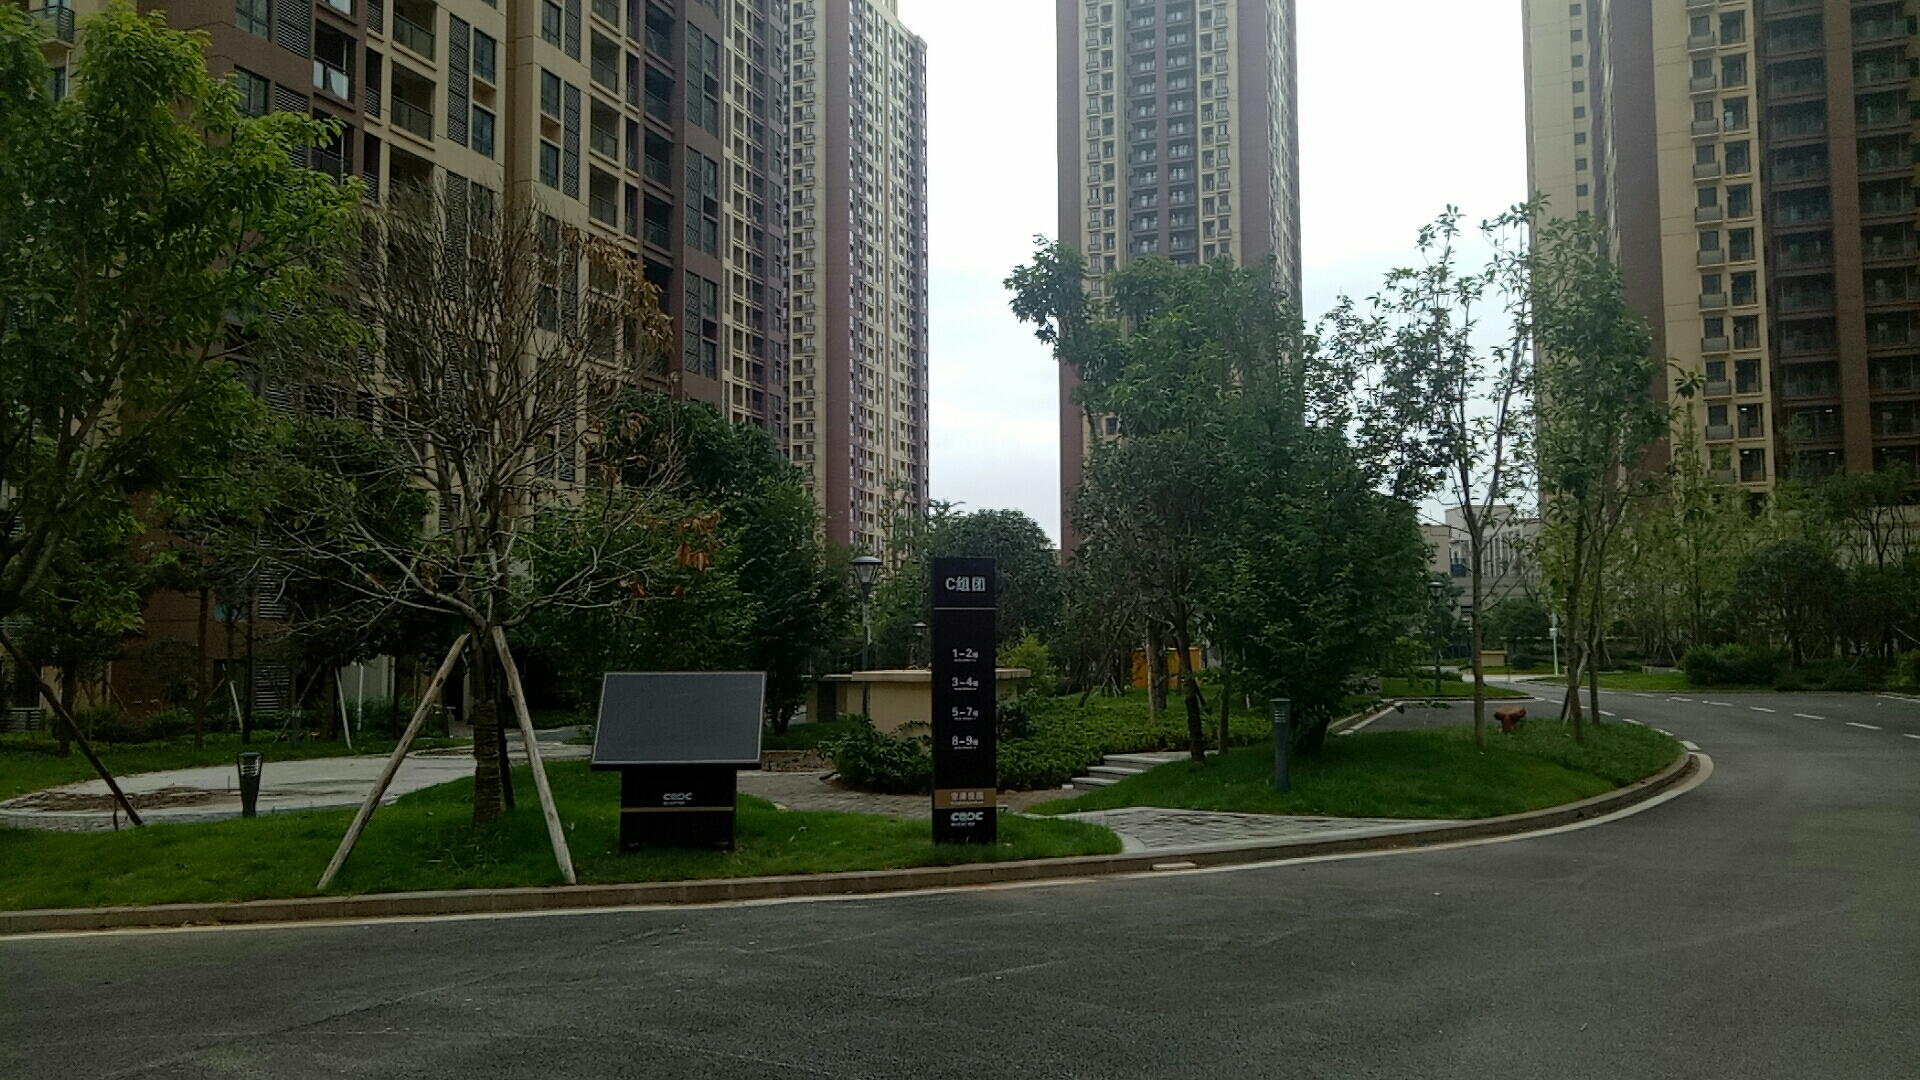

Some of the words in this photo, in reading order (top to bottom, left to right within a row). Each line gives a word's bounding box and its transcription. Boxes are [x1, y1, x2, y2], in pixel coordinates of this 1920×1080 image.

[945, 576, 986, 592] C组团
[952, 647, 979, 659] 1-2
[951, 676, 979, 687] 3-4
[951, 706, 979, 717] 5-7
[951, 735, 979, 746] 8-9
